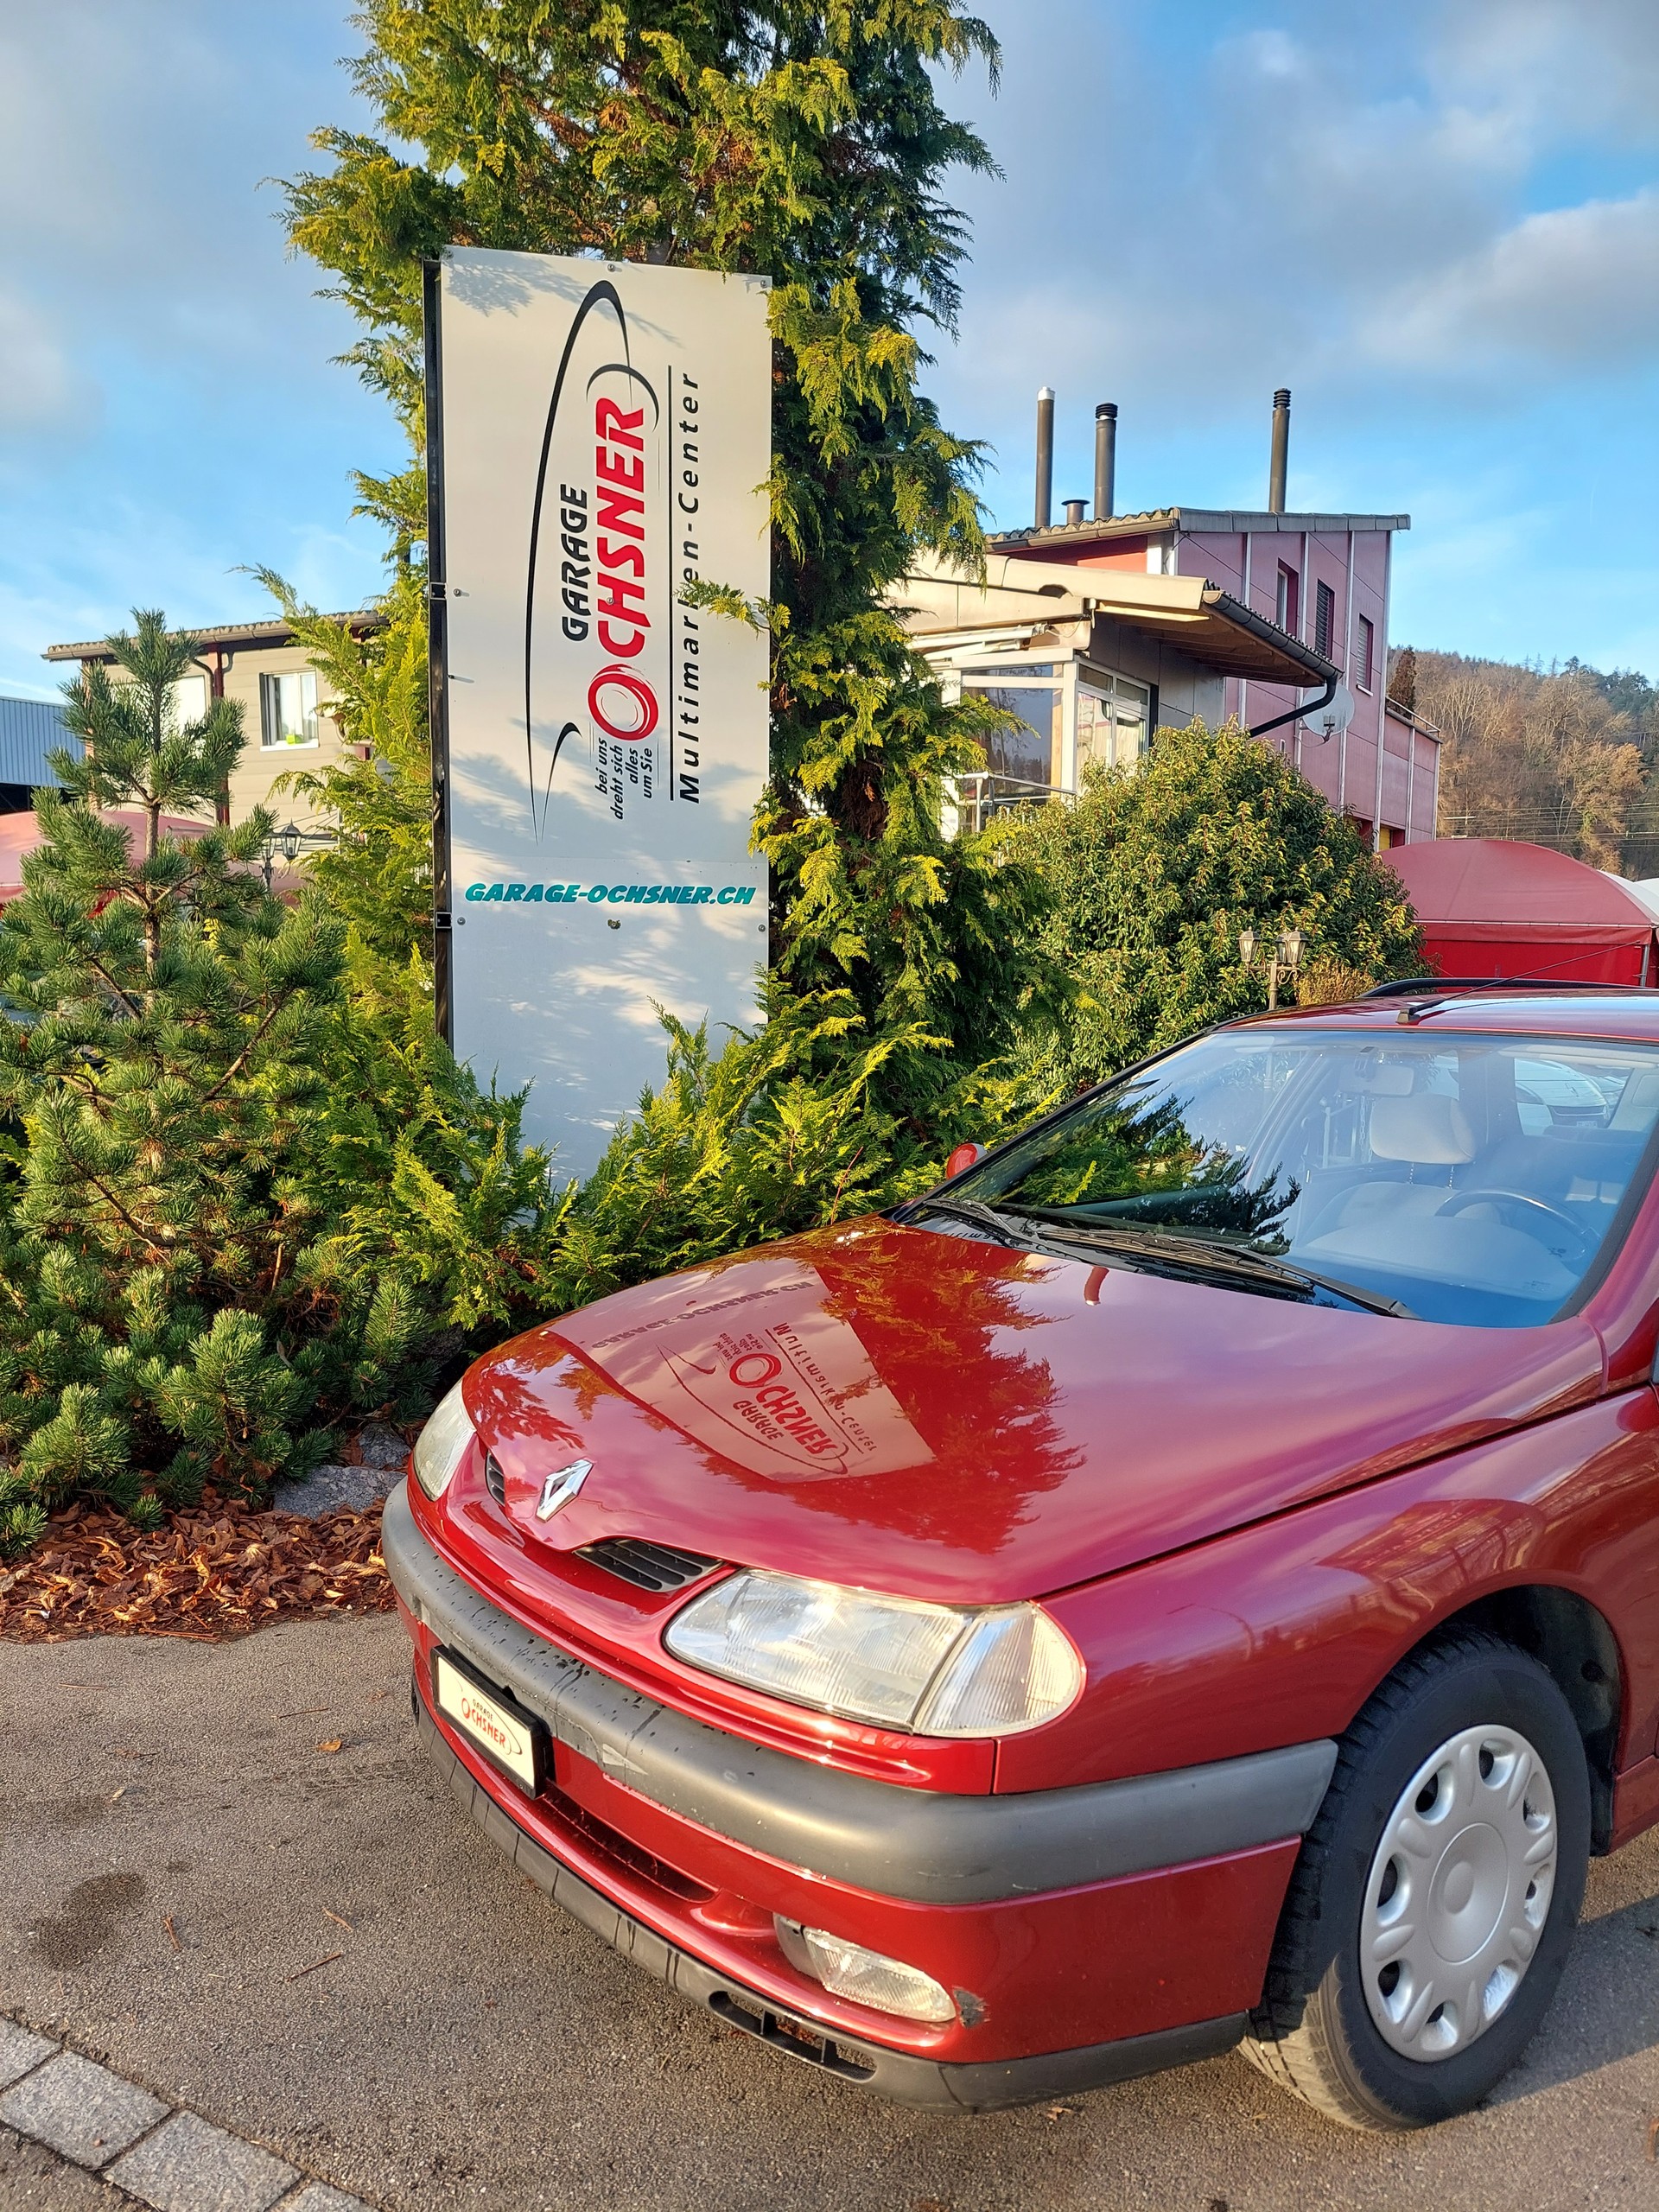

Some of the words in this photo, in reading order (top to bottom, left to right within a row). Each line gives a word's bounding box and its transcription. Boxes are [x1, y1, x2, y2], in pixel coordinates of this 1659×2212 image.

[560, 483, 592, 642] GARAGE
[588, 397, 659, 741] OCHSNER
[598, 737, 607, 766] uns
[609, 745, 623, 775] sich
[625, 747, 639, 785] alles
[640, 747, 652, 772] Sie
[594, 766, 608, 795] bei
[643, 775, 652, 799] um
[610, 777, 624, 820] dreht
[465, 883, 757, 905] GARAGE-OCHSNER.CH
[461, 1697, 506, 1749] OCHSNER
[473, 1699, 493, 1721] GARAGE
